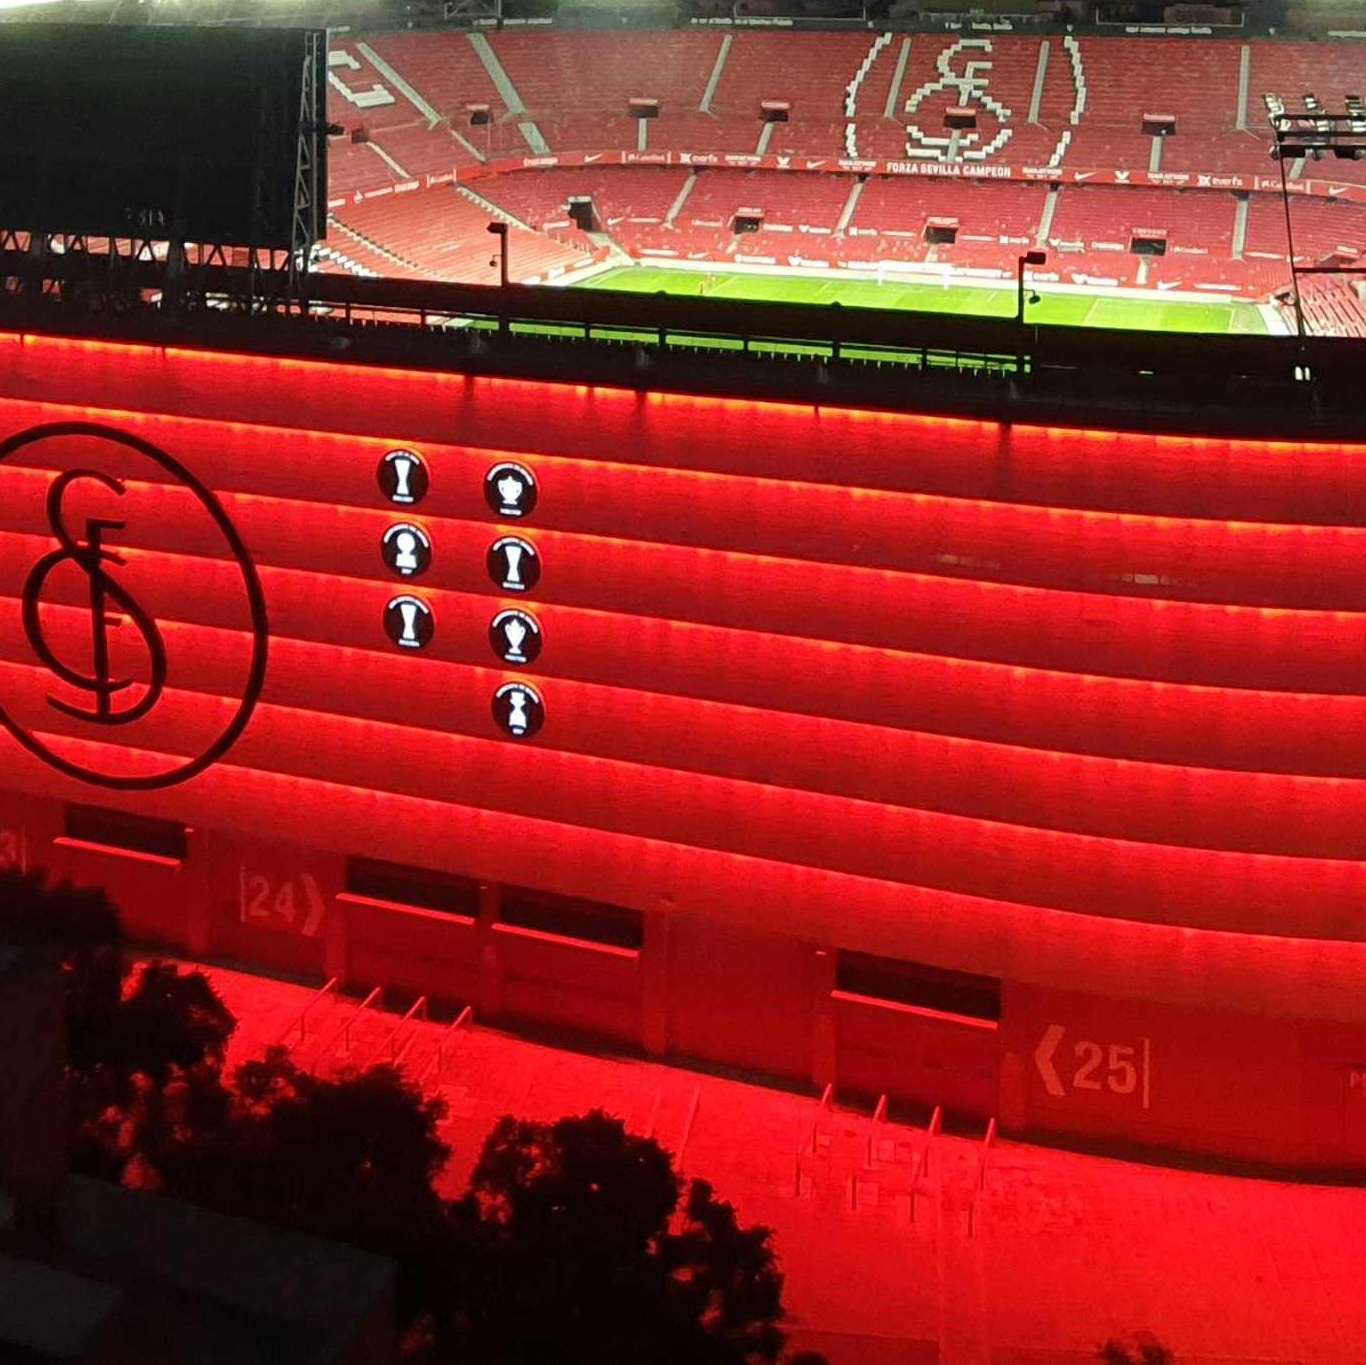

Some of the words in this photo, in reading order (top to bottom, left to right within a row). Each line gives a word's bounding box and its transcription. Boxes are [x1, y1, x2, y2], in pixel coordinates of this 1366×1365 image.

[886, 161, 918, 174] FORZA
[920, 162, 960, 176] SEVILLA
[248, 874, 296, 923] 24
[1072, 1040, 1137, 1095] 25
